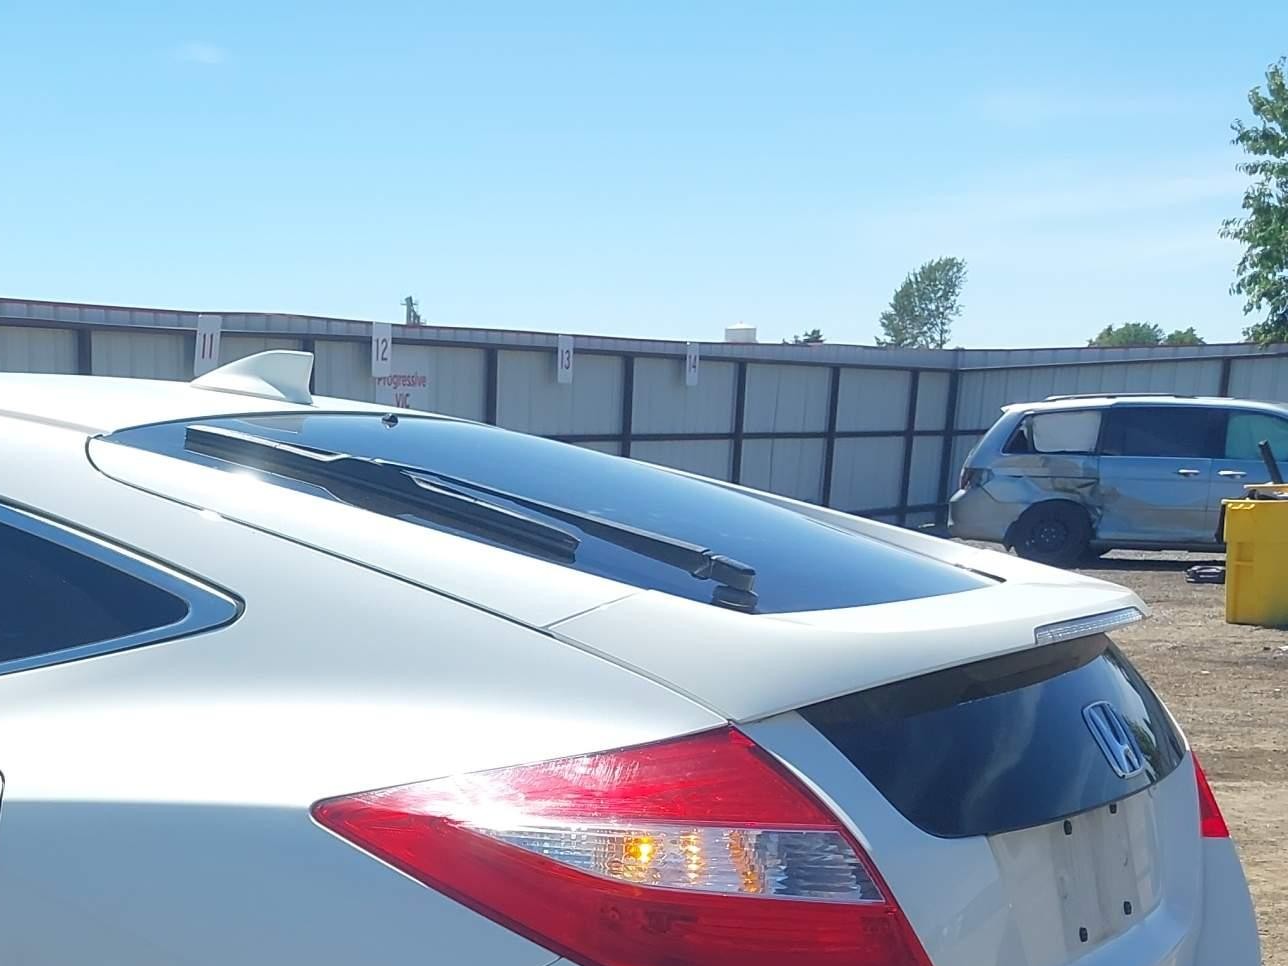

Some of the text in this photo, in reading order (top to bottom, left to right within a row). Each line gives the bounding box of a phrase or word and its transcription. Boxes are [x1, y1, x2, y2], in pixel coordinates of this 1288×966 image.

[202, 333, 213, 359] 11
[375, 337, 388, 361] 12
[560, 349, 571, 370] 13
